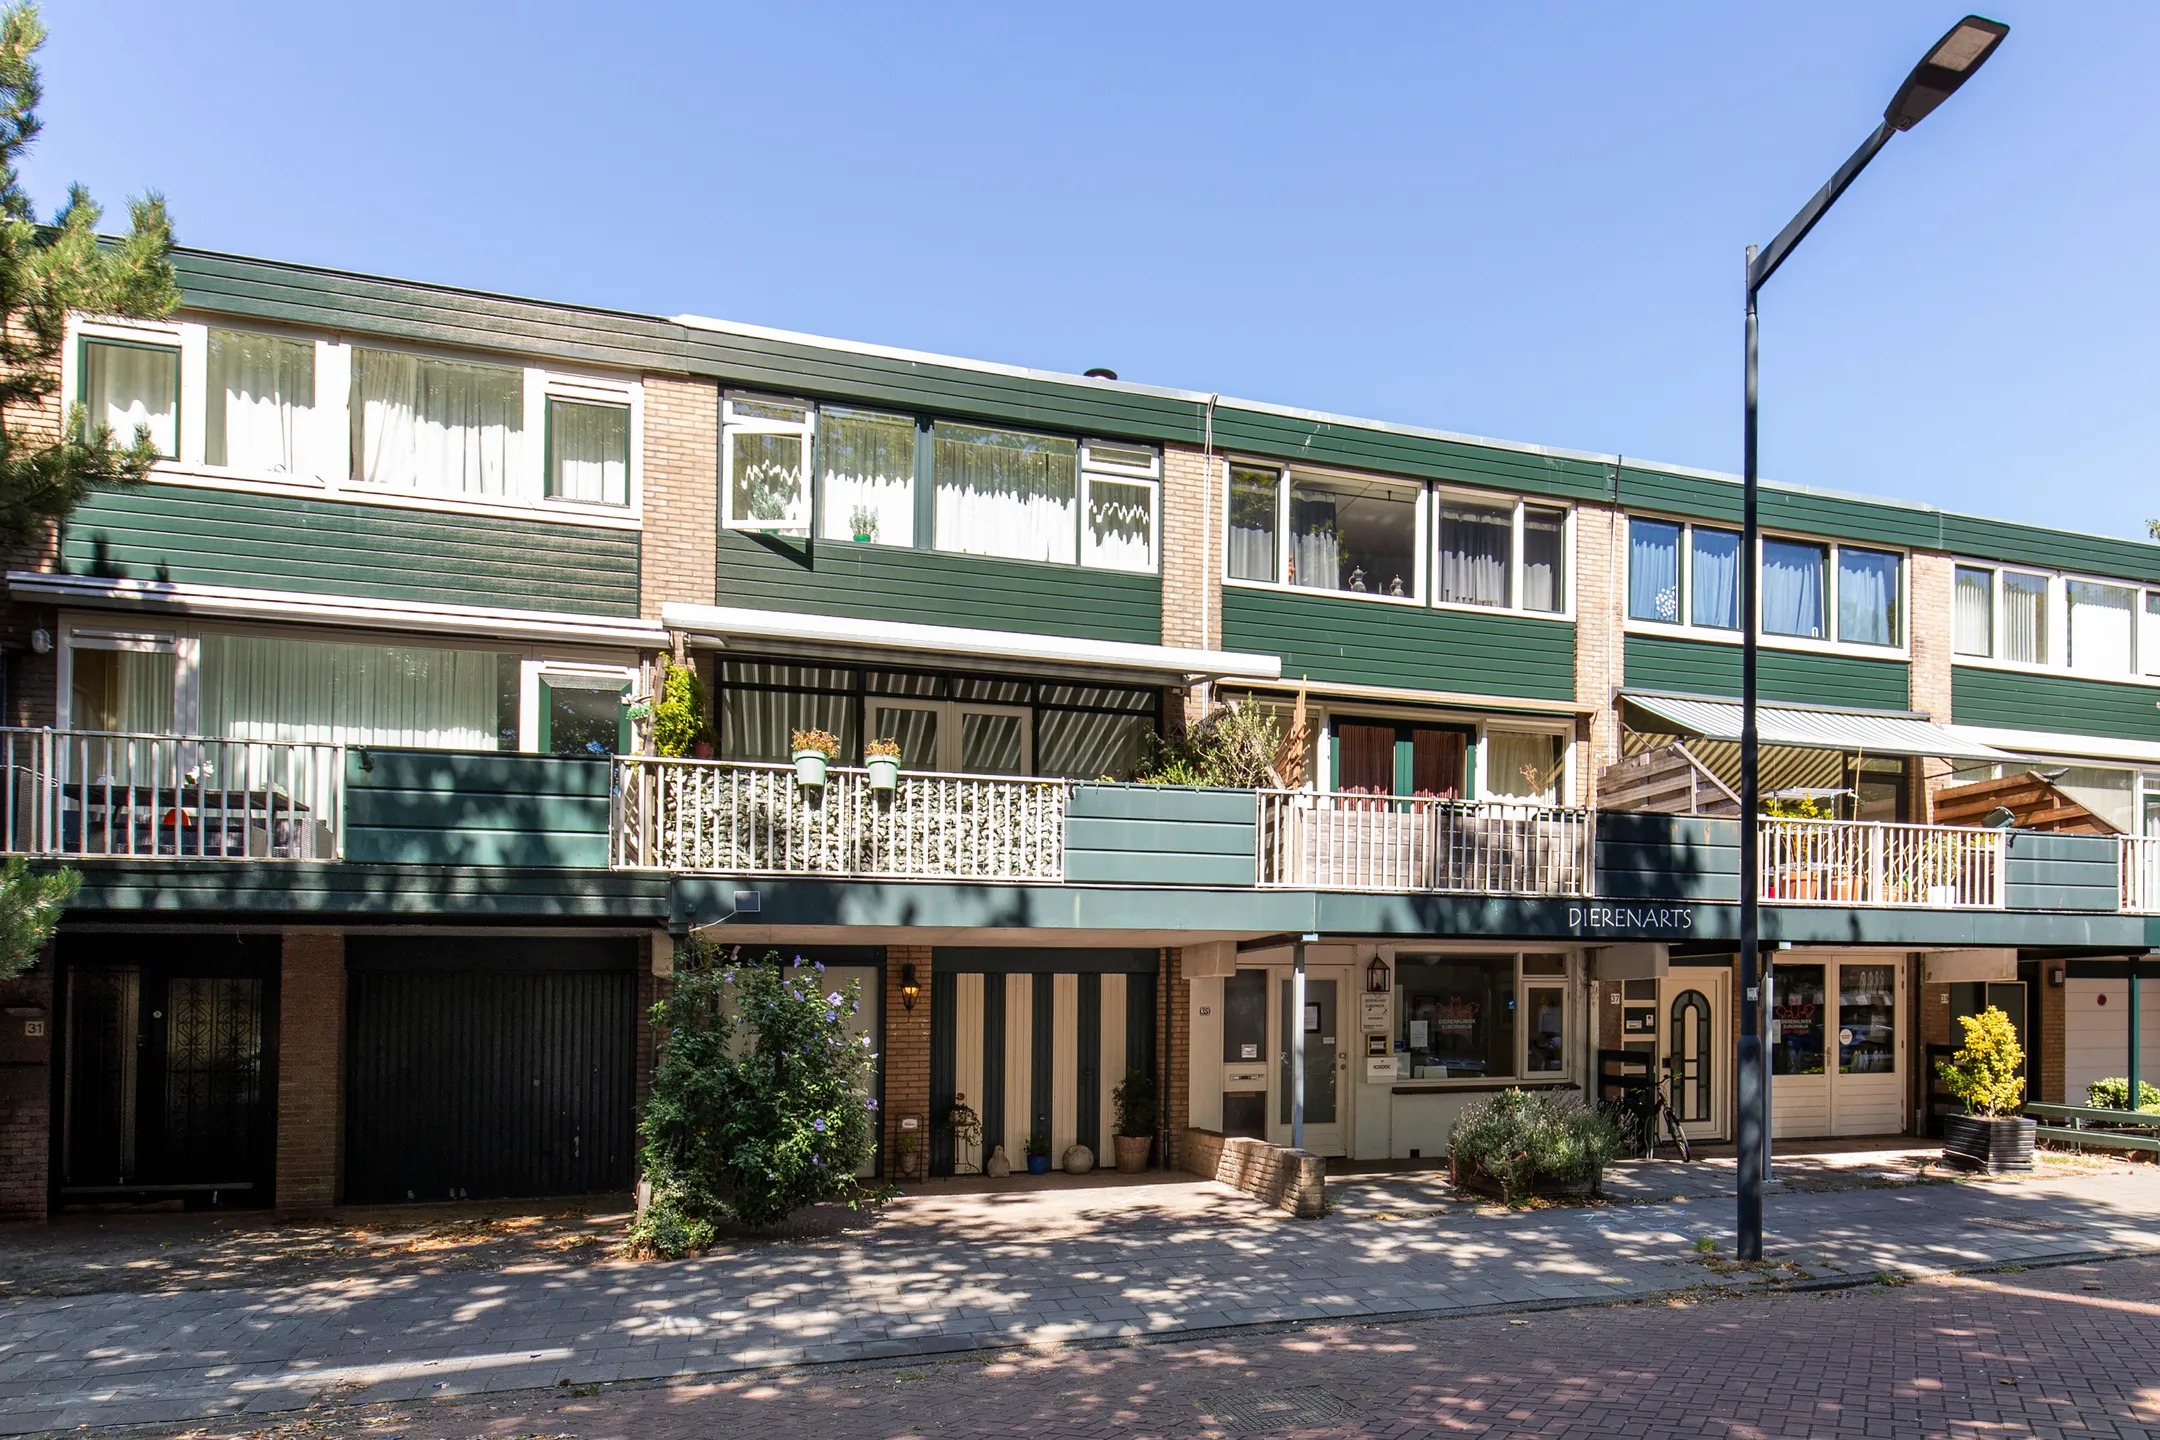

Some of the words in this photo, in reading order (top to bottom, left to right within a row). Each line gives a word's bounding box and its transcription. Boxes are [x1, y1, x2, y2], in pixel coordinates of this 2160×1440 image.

[1569, 907, 1692, 929] DIERENARTS
[1611, 994, 1620, 1003] 37
[28, 1023, 42, 1034] 31
